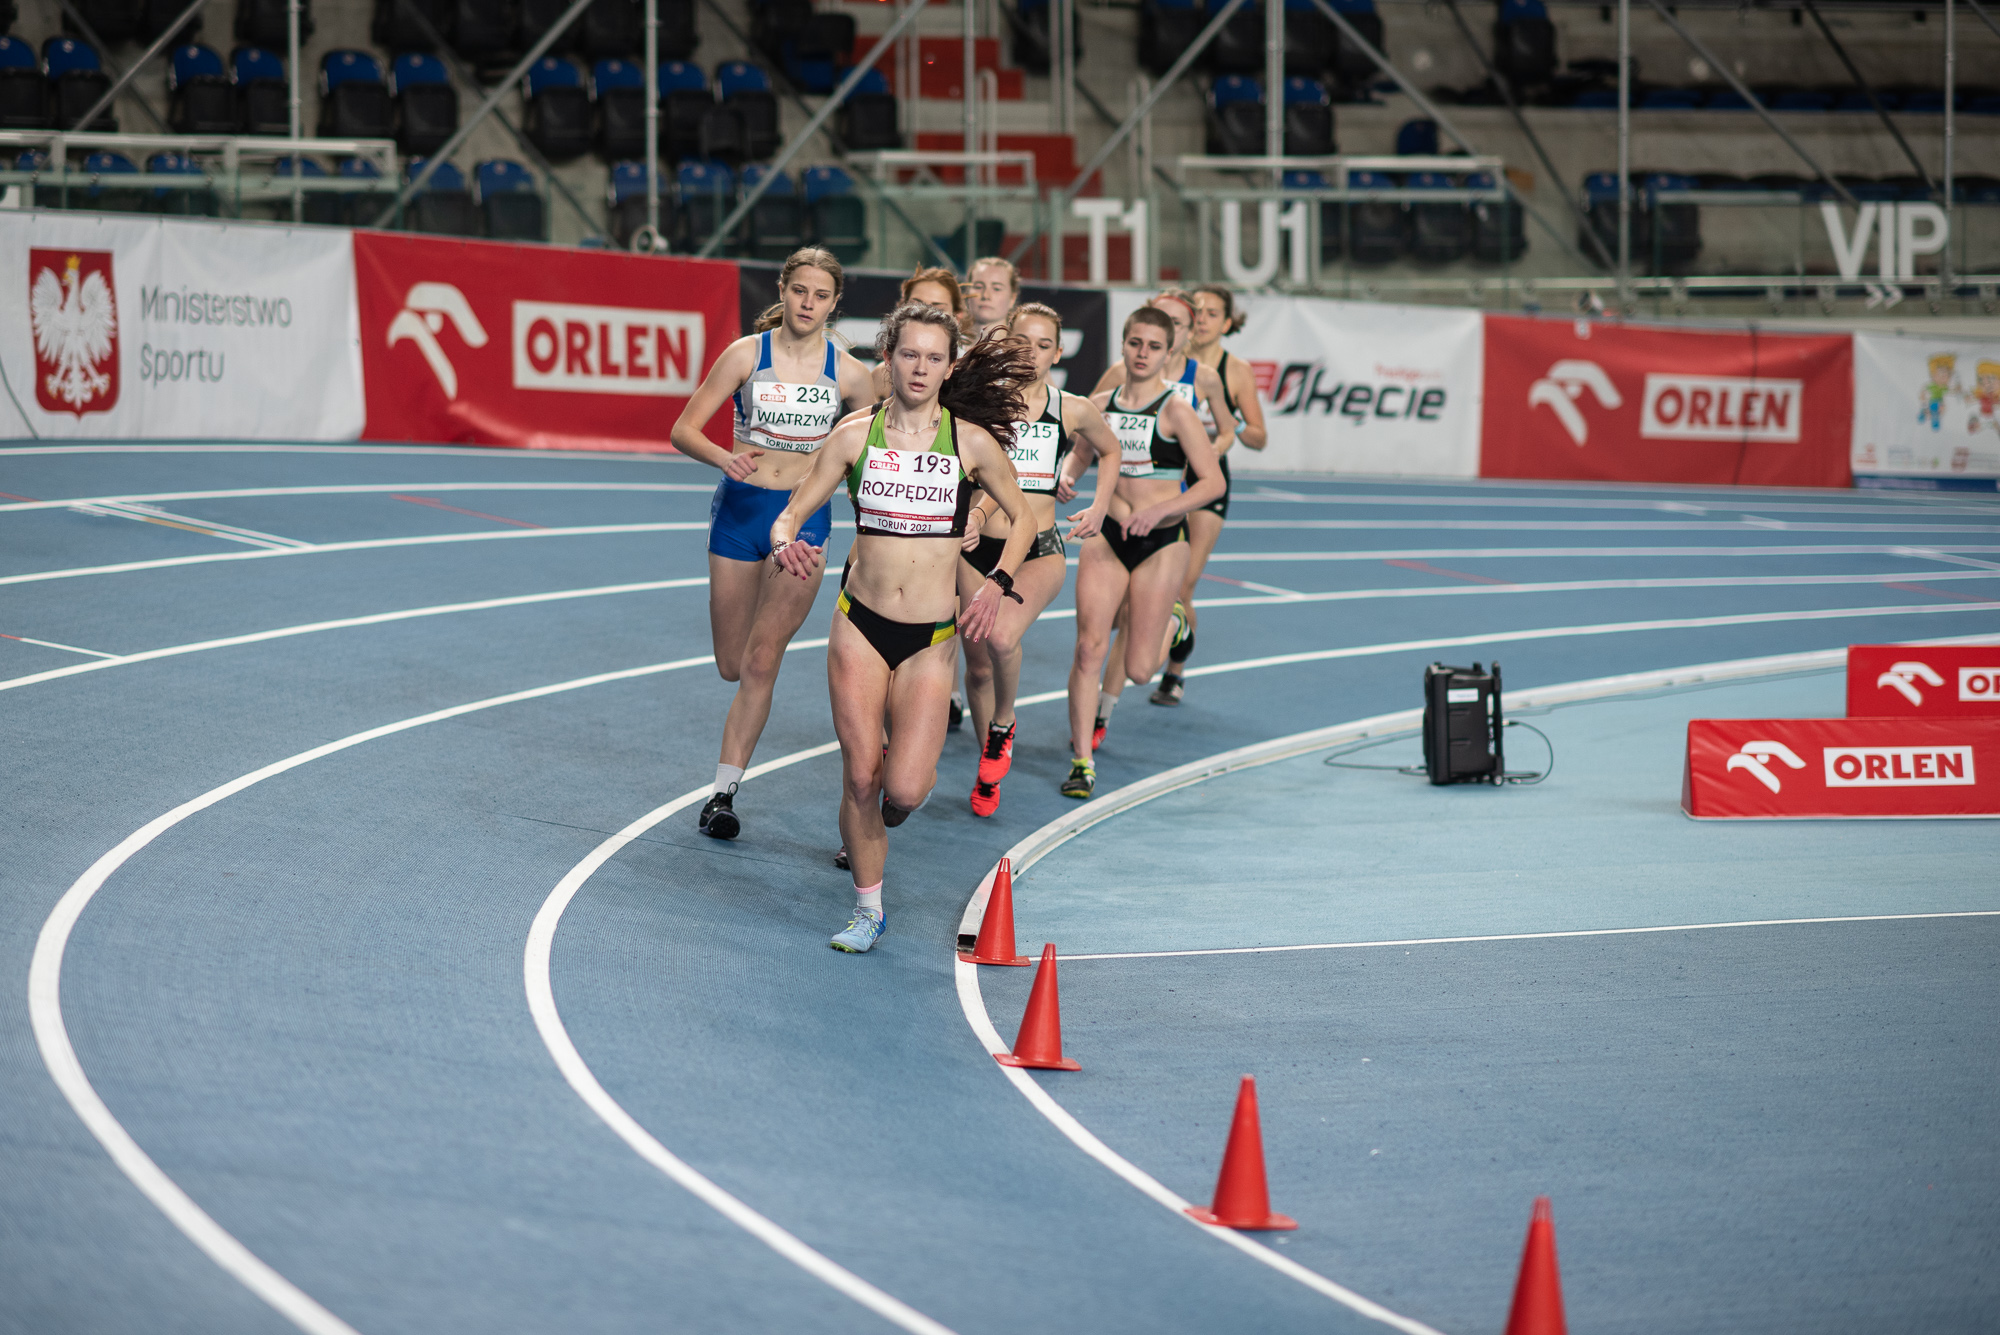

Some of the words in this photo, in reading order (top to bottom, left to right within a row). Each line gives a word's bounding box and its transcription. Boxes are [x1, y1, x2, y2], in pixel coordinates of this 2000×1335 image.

[1071, 199, 1147, 286] T1
[1221, 199, 1308, 287] U1
[1819, 200, 1949, 282] VIP
[526, 316, 690, 381] ORLEN
[140, 343, 225, 388] Sportu
[761, 394, 785, 402] ORLEN
[796, 387, 831, 404] 234
[757, 409, 831, 427] WIATRZYK
[1653, 384, 1791, 431] ORLEN
[1020, 423, 1052, 438] 915
[1120, 416, 1148, 430] 224
[766, 438, 793, 450] TORUŃ
[795, 443, 814, 451] 2021
[870, 461, 899, 472] ORLEN
[913, 455, 951, 475] 193
[862, 480, 955, 503] ROZPĘDZIK
[1023, 479, 1040, 487] 2021
[877, 518, 907, 531] TORUŃ
[910, 523, 932, 532] 2021
[1833, 752, 1964, 781] ORLEN
